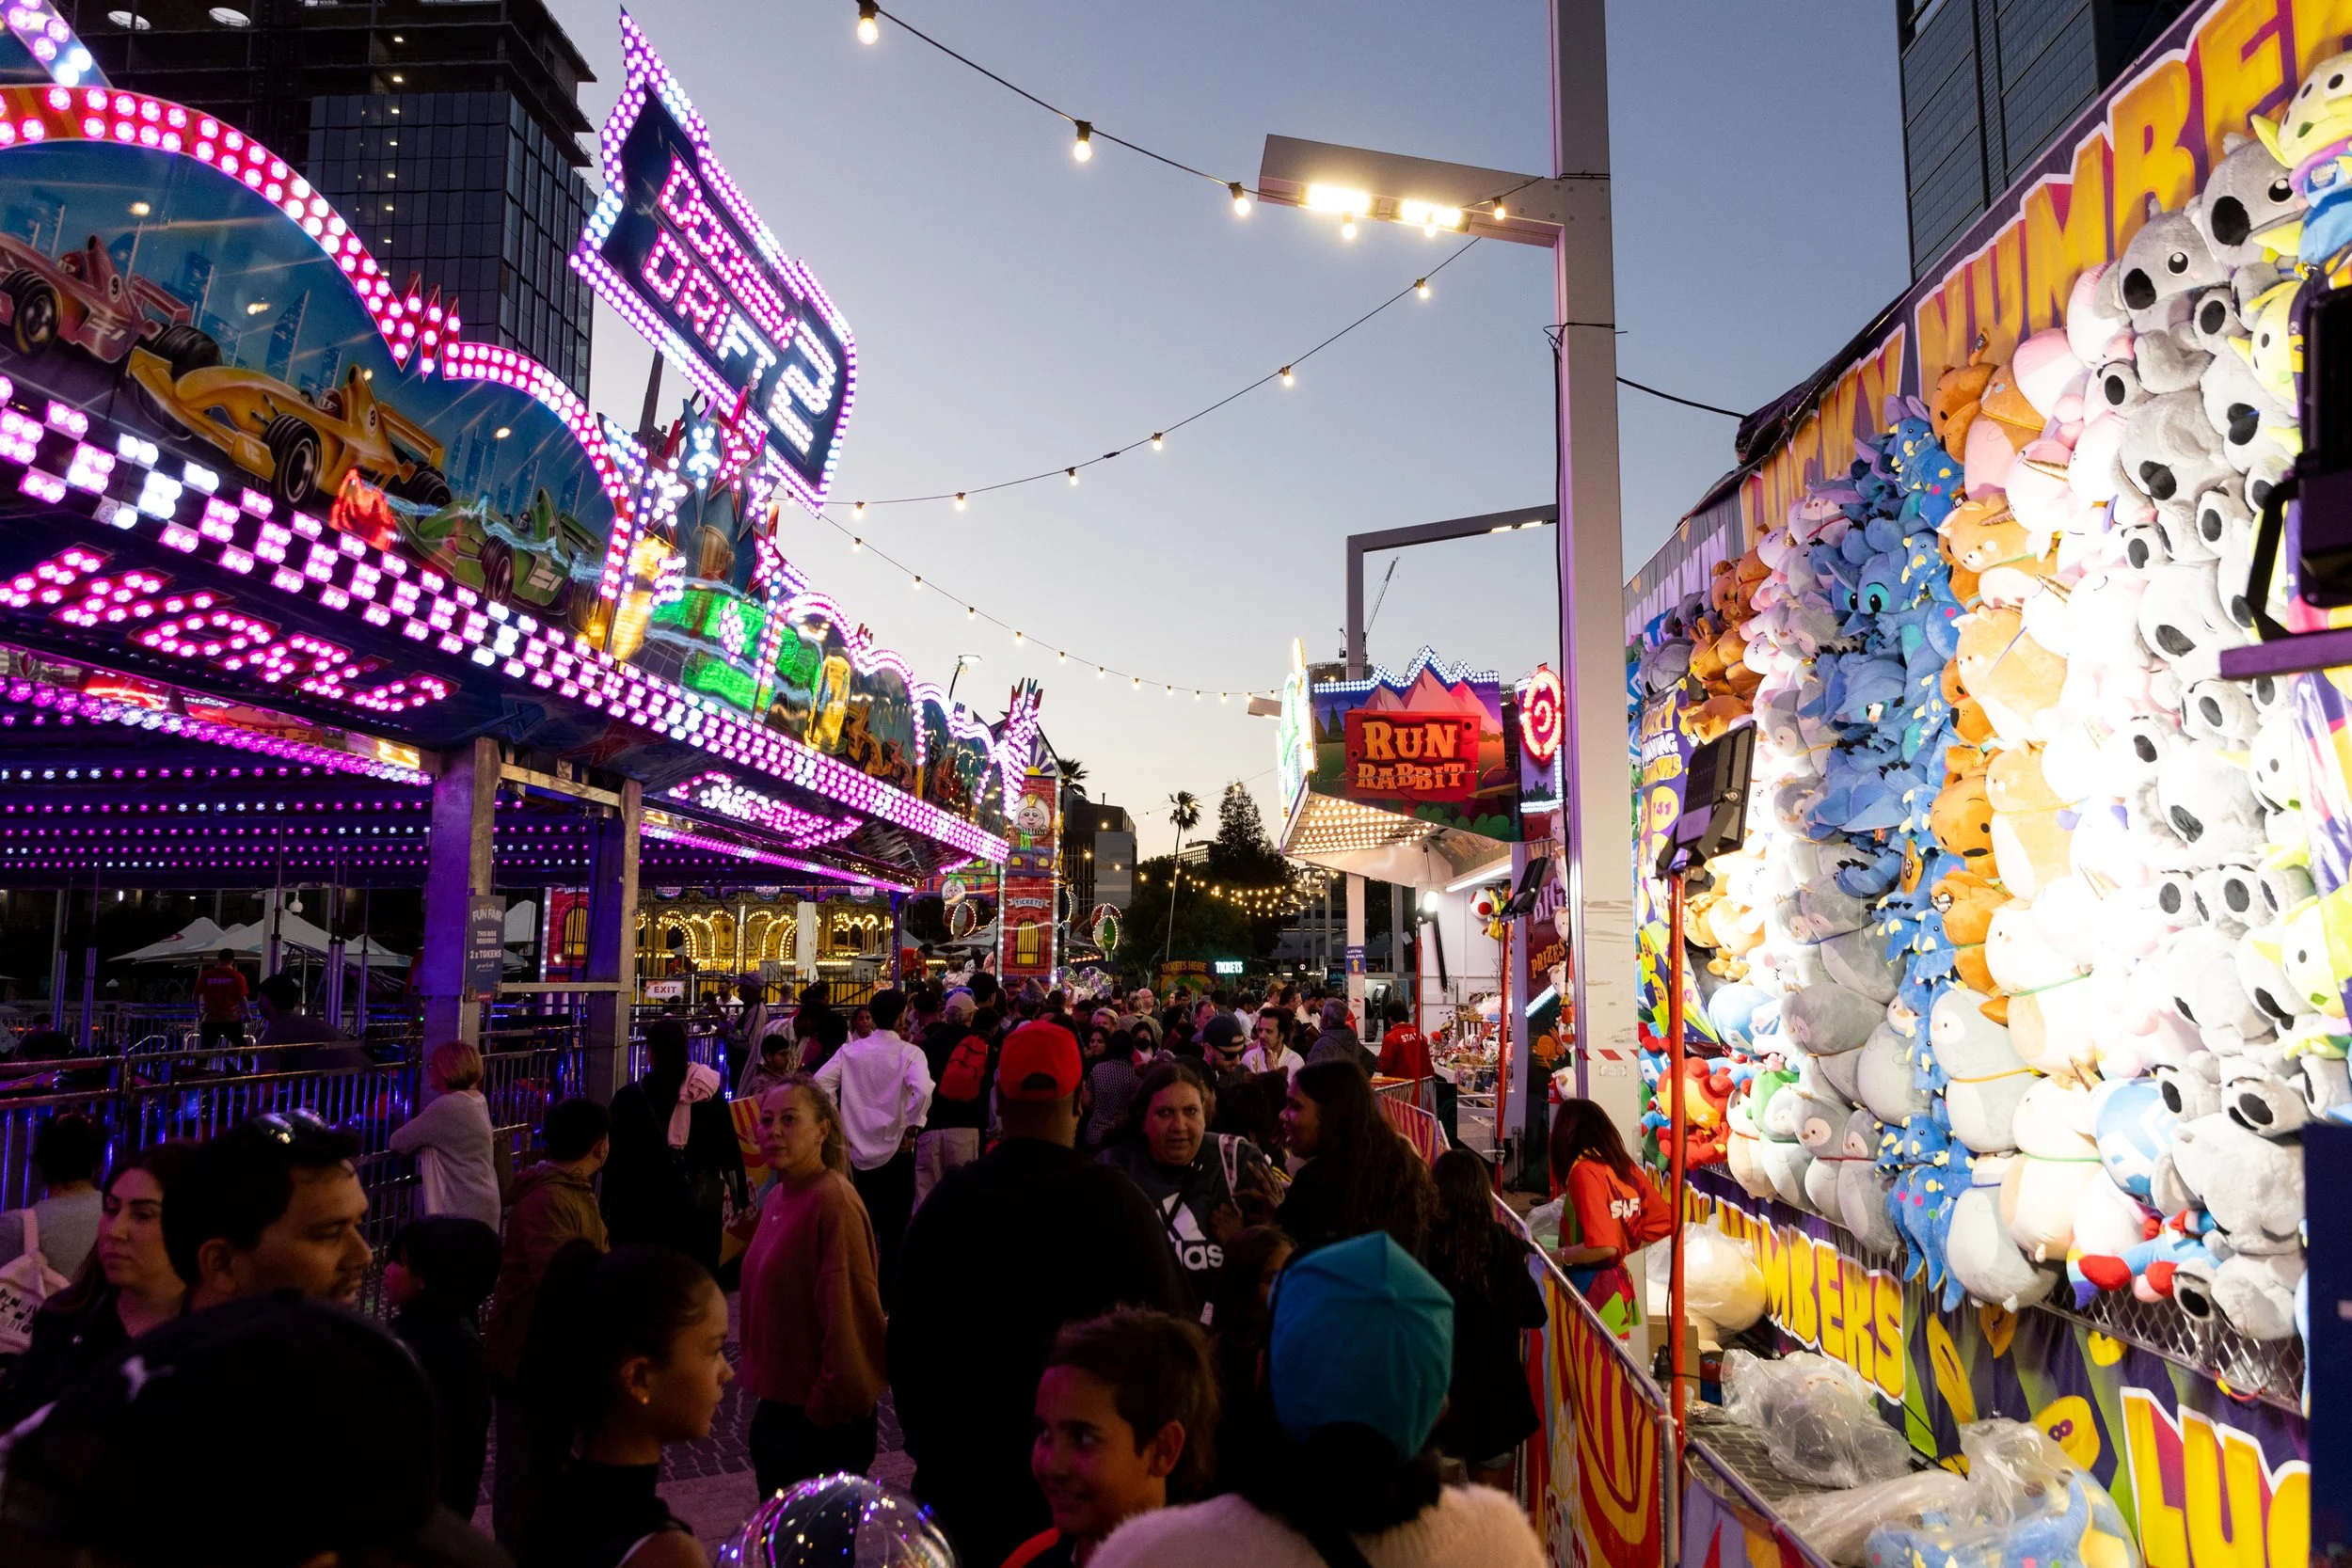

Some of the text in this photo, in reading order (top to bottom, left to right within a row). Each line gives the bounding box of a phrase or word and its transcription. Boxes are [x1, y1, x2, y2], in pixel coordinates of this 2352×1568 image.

[642, 229, 777, 389] DRIFT
[1362, 721, 1458, 761] RUN
[1357, 763, 1467, 791] RABBIT
[1016, 898, 1042, 908] TICKETS
[472, 909, 503, 923] FUN FAIR
[479, 949, 502, 959] TOKENS
[1531, 938, 1566, 979] PRIZES
[1162, 960, 1207, 974] TICKETS HERE
[1216, 960, 1243, 974] TICKETS
[654, 986, 677, 994] EXIT
